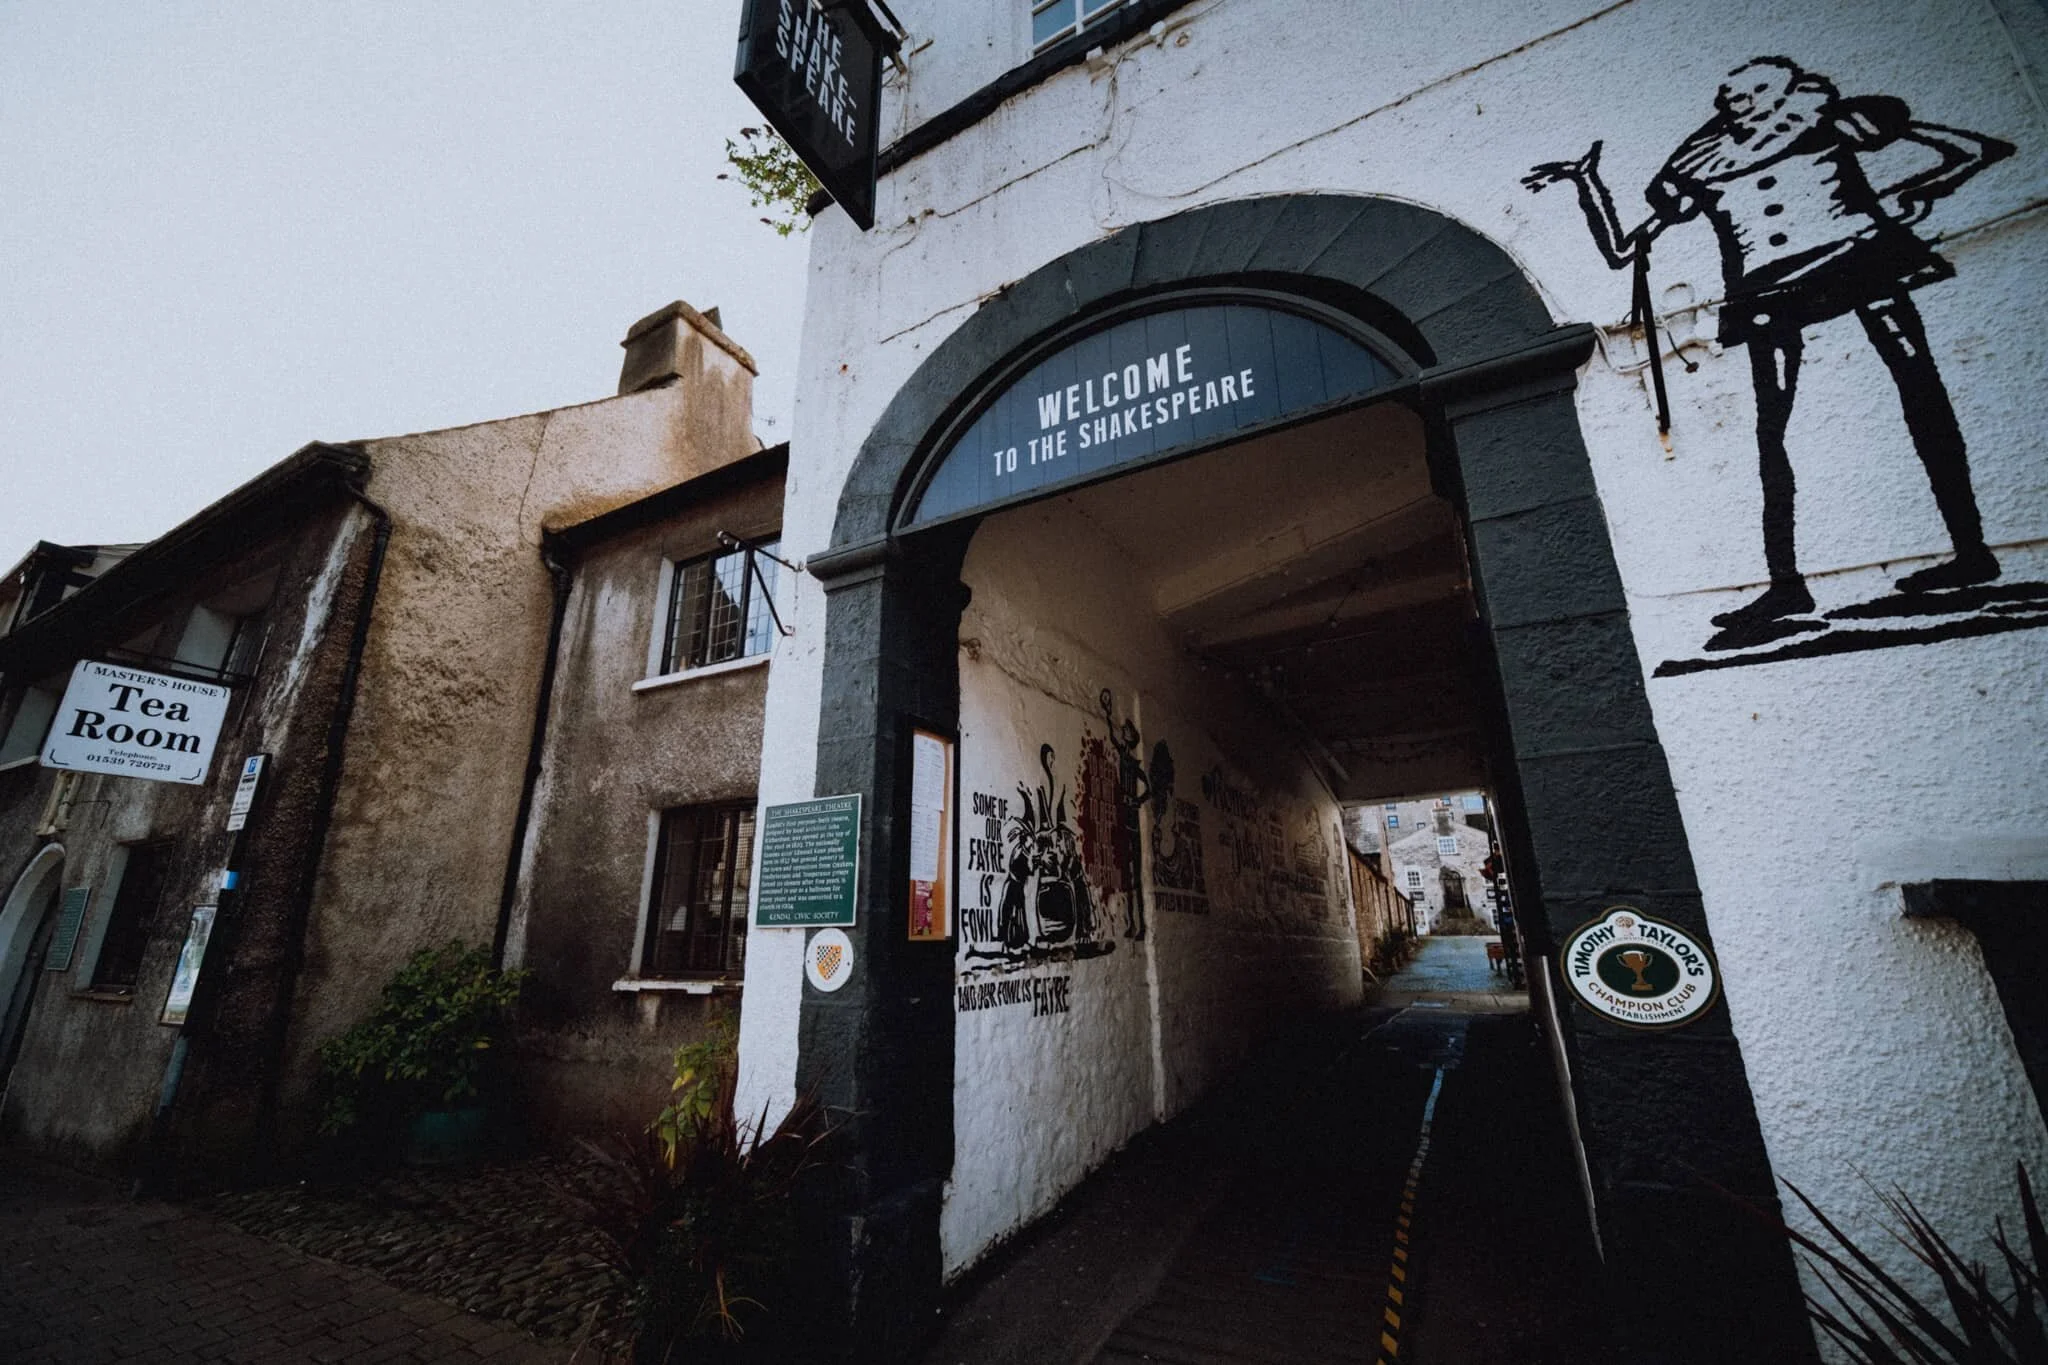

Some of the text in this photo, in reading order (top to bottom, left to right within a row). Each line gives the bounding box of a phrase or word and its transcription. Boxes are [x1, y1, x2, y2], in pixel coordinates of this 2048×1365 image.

[776, 25, 856, 147] SPEARE
[1038, 344, 1193, 430] WELCOME
[994, 368, 1255, 476] TO THE SHAKESPEARE
[94, 666, 218, 697] MASTER'S HOUSE
[108, 683, 190, 722] Tea
[66, 709, 201, 753] Room
[87, 753, 171, 771] 01539 720723
[973, 792, 1008, 820] SOME OF
[985, 818, 1002, 841] OUR
[968, 838, 1006, 873] FAYRE
[980, 874, 994, 907] IS
[961, 908, 998, 943] FOWL
[1574, 924, 1704, 977] TIMOTHY TAYLOR'S
[958, 976, 1070, 1017] AND OUR FOWL IS FAYRE
[1588, 982, 1696, 1012] CHAMPION CLUB
[1610, 1005, 1687, 1020] ESTABLISHMENT
